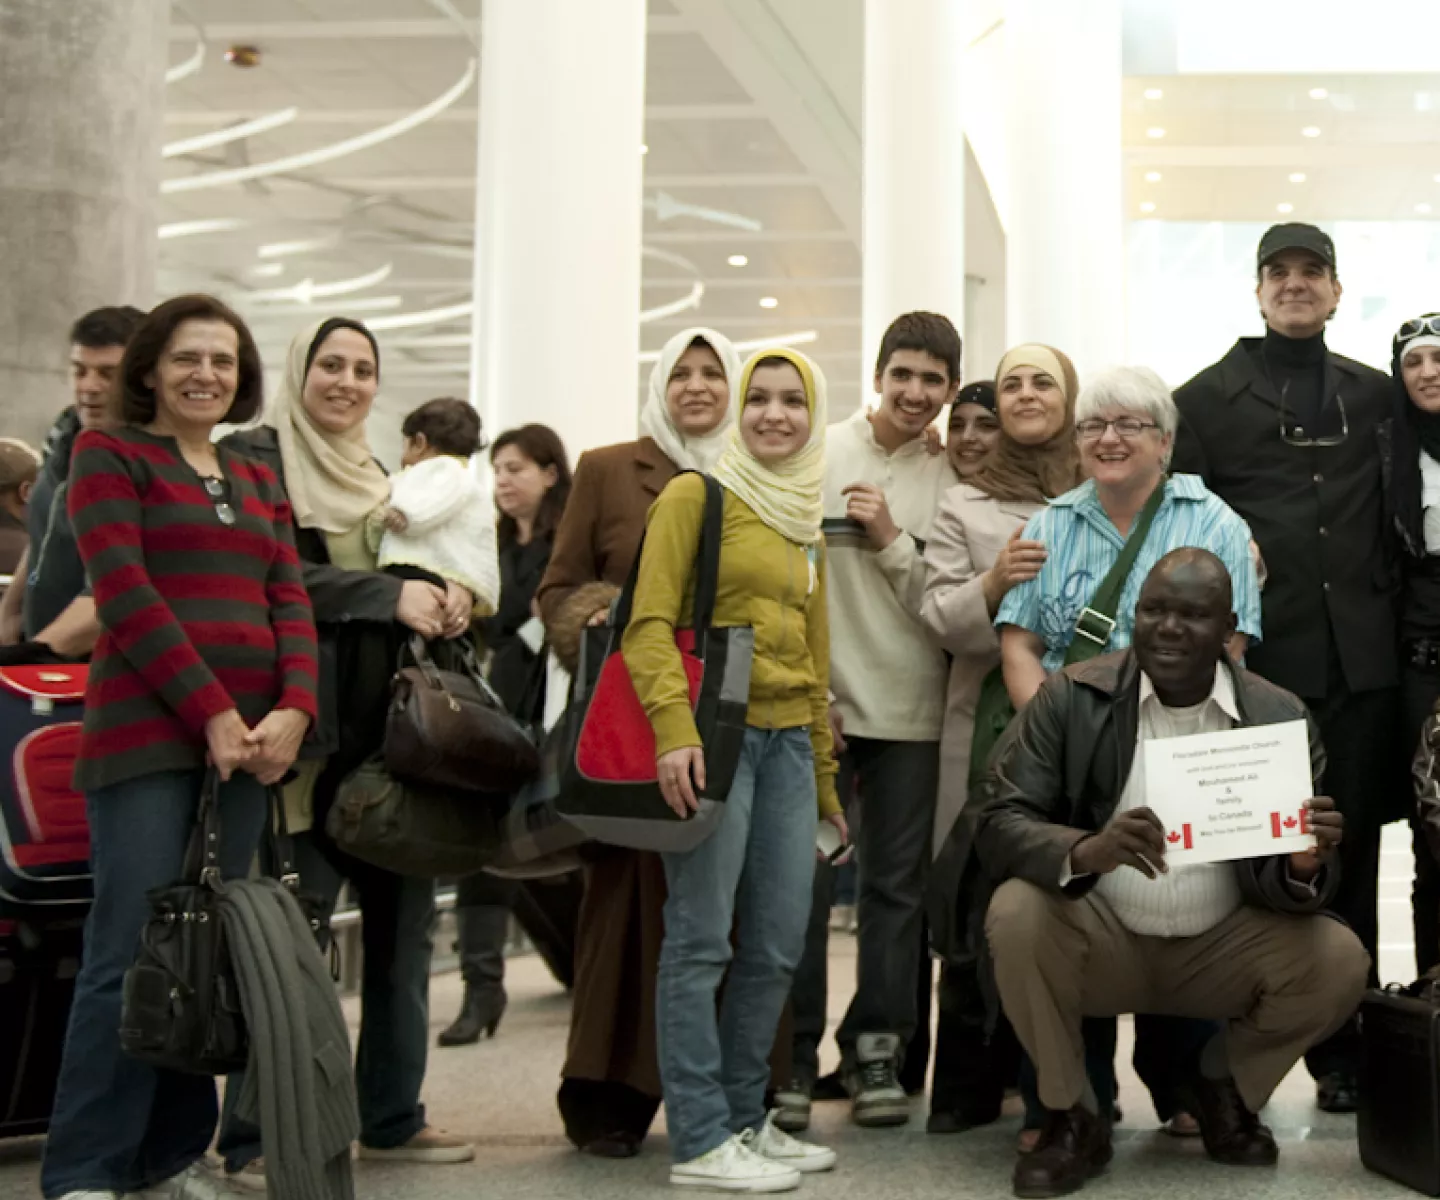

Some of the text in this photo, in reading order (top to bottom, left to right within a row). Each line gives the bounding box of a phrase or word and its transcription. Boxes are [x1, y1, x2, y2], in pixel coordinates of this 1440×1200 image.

[1252, 740, 1281, 749] Church
[1225, 786, 1233, 795] &
[1216, 796, 1242, 805] family
[1219, 810, 1253, 820] Canada
